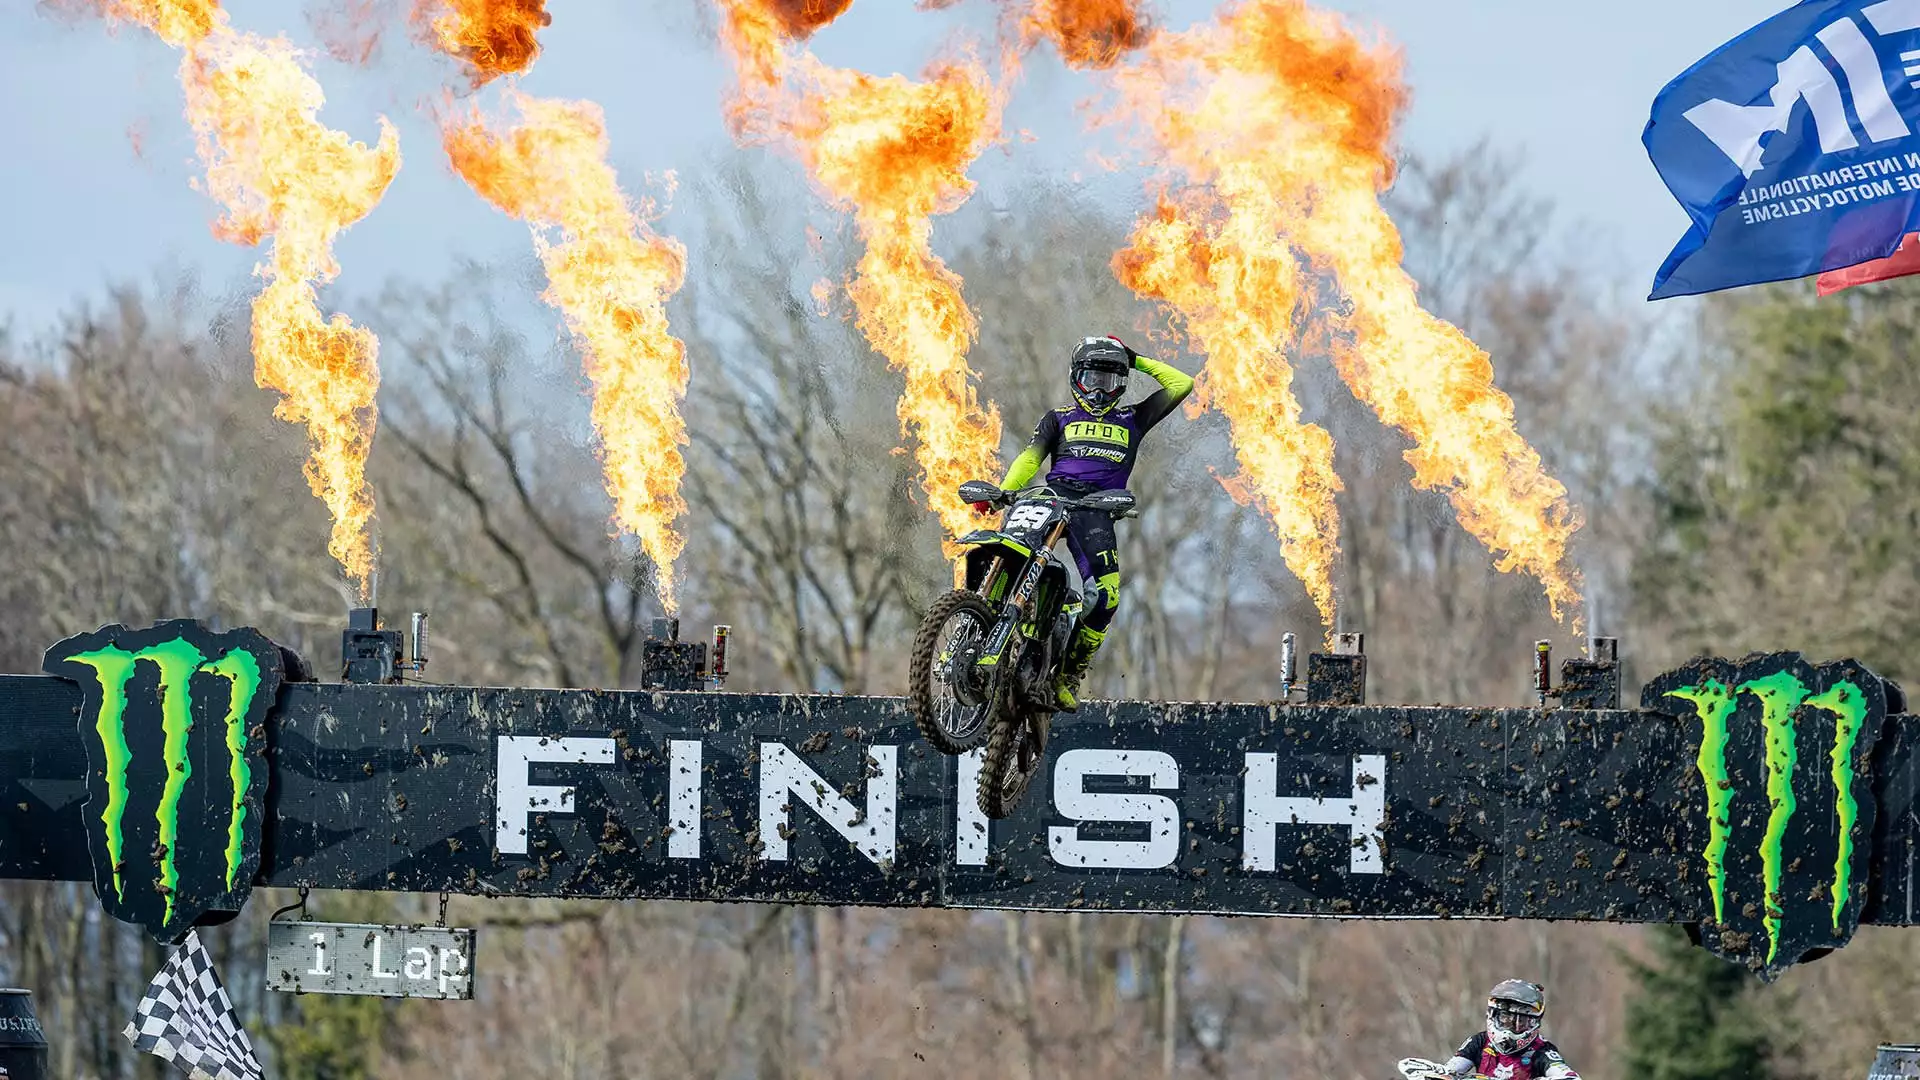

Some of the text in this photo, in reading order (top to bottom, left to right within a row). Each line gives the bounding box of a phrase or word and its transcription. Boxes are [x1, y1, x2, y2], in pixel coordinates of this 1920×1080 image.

[1006, 505, 1053, 530] 99
[496, 736, 1386, 874] FINISH
[307, 932, 468, 994] 1 Lap
